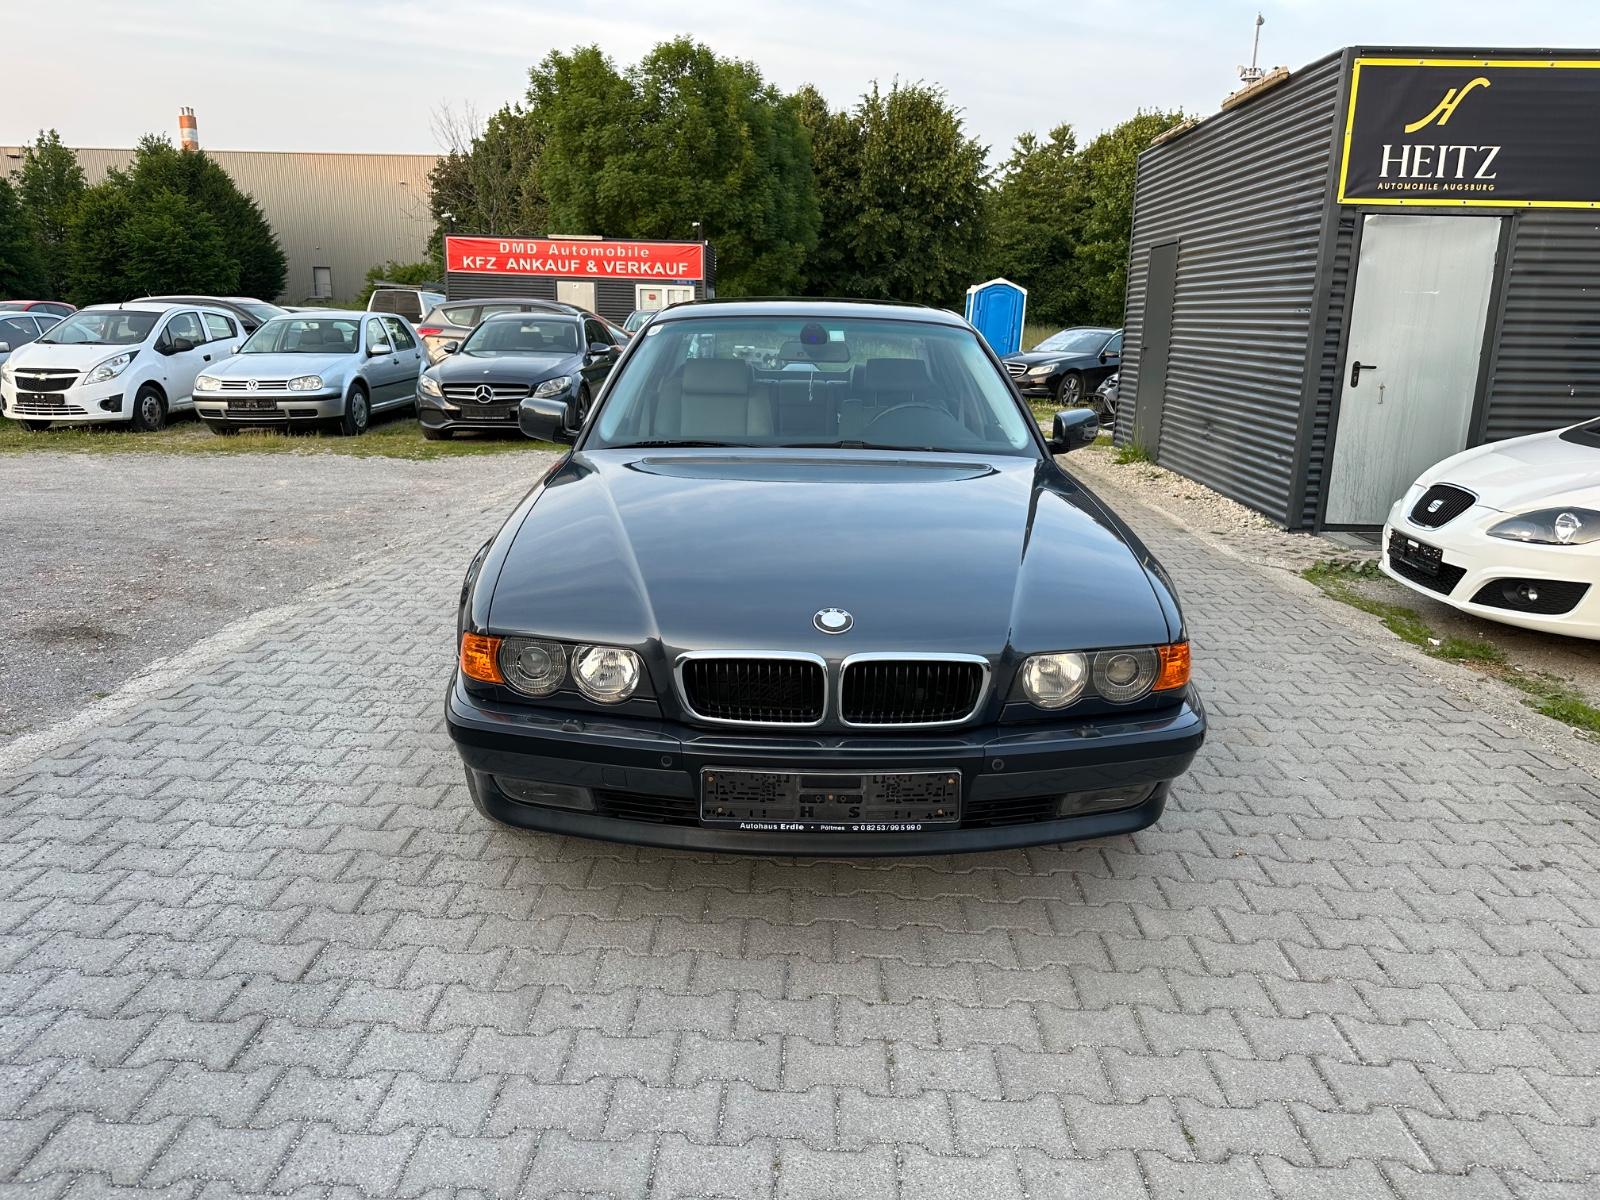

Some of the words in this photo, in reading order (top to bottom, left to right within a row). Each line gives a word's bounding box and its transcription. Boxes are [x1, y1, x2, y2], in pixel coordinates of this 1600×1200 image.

[1378, 144, 1501, 179] HEITZ
[1377, 182, 1439, 191] AUTOMOBILE
[1442, 183, 1495, 191] AUGSBURG
[500, 242, 537, 254] DMD
[548, 244, 650, 258] Automobile
[463, 256, 497, 269] KFZ
[506, 258, 580, 272] ANKAUF
[586, 259, 598, 273] &
[603, 261, 689, 275] VERKAUF
[740, 822, 778, 830] Autohaus
